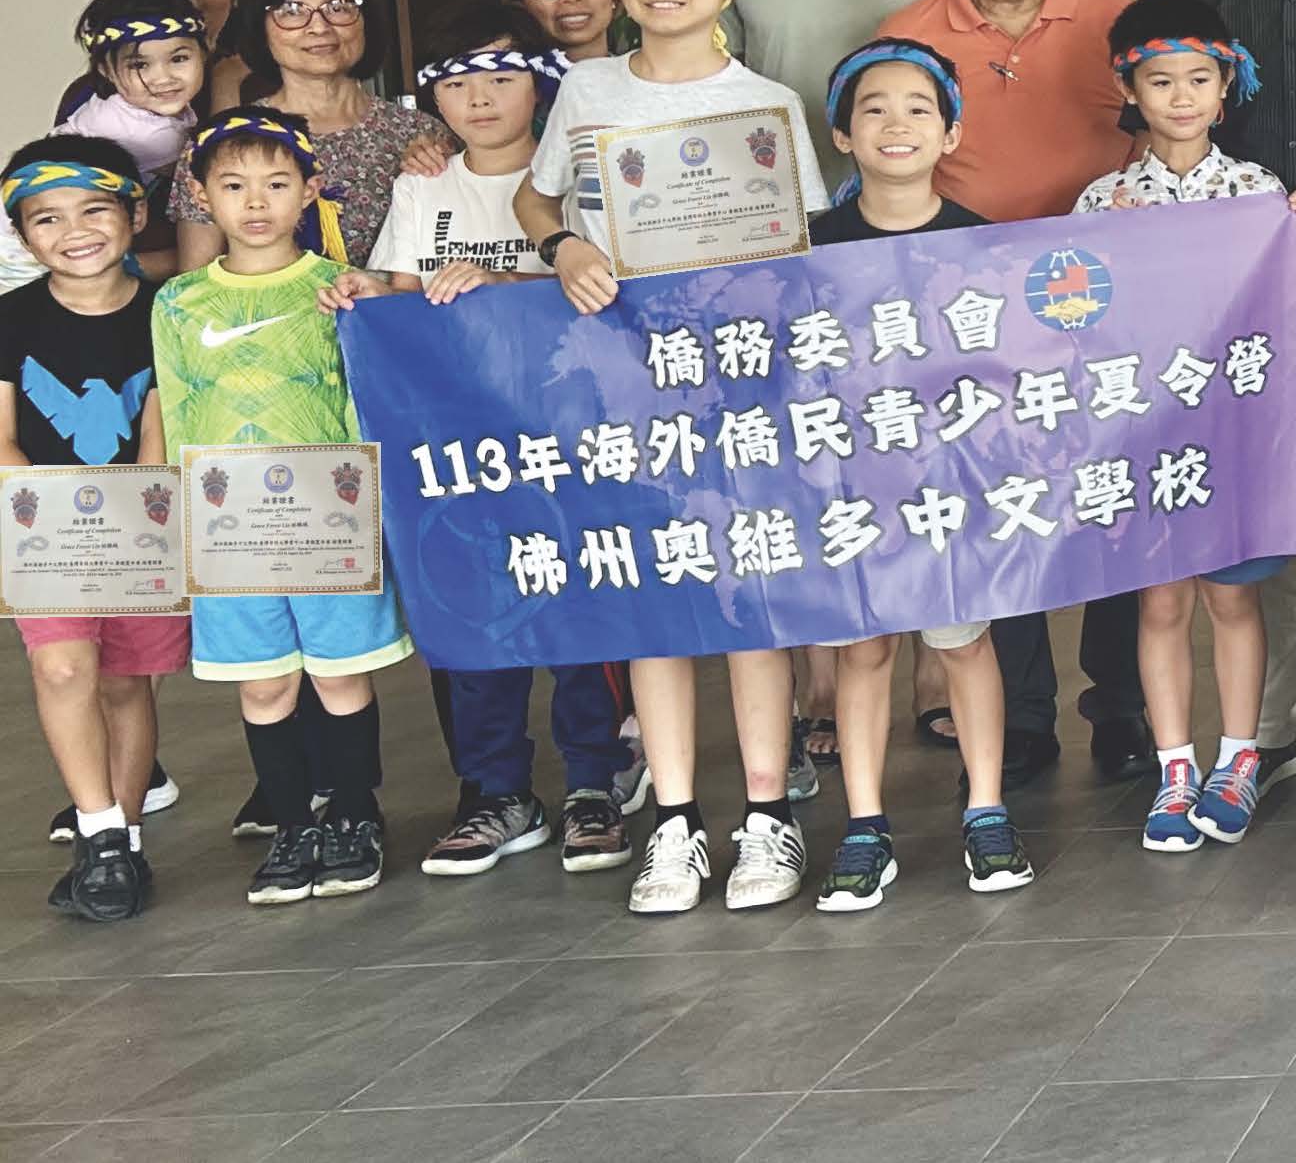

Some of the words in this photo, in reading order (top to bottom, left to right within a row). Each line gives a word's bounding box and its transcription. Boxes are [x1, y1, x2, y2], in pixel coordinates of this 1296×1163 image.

[463, 238, 539, 256] MINECRA
[648, 290, 1007, 389] 僑務委員會
[411, 334, 1274, 499] 113年海外僑民青少年夏令營
[507, 450, 1213, 597] 佛州奧維多中文學校
